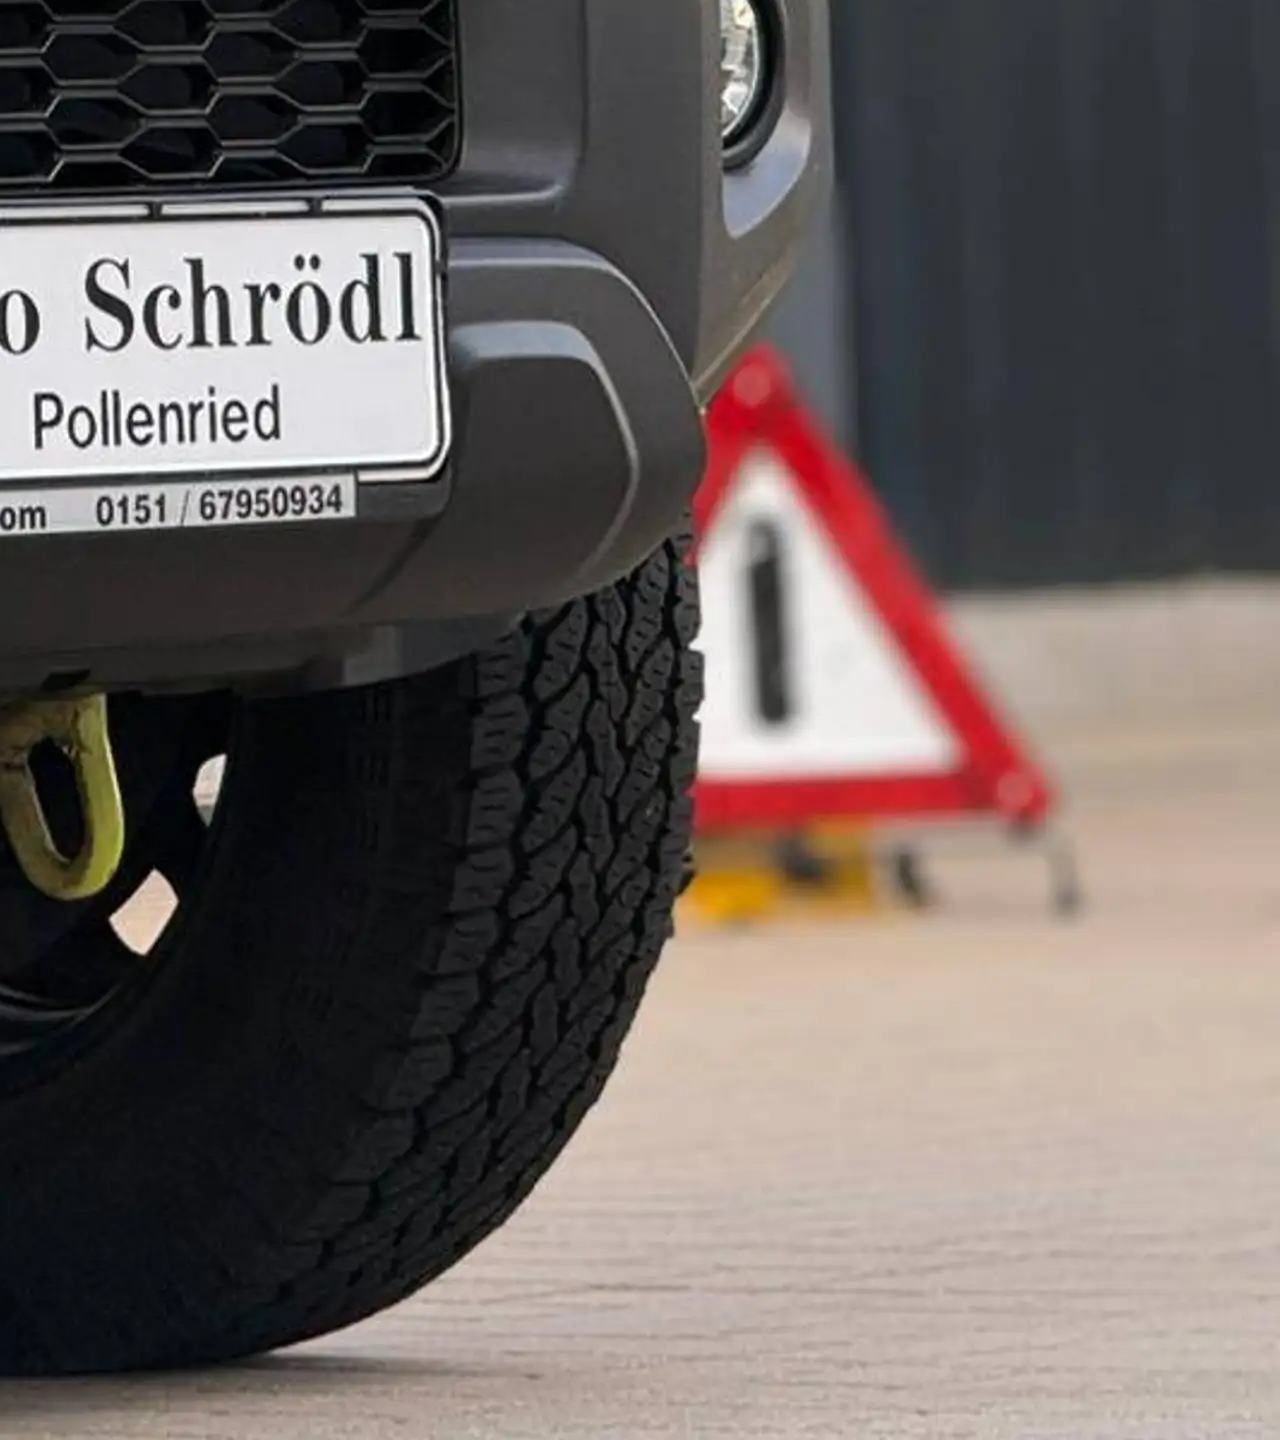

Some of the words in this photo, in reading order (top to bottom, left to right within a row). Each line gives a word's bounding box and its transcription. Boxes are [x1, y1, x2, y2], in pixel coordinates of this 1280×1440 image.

[83, 252, 423, 353] Schrödl
[33, 383, 282, 450] Pollenried
[95, 492, 166, 526] 0151
[179, 489, 191, 527] /
[198, 484, 344, 521] 67950934
